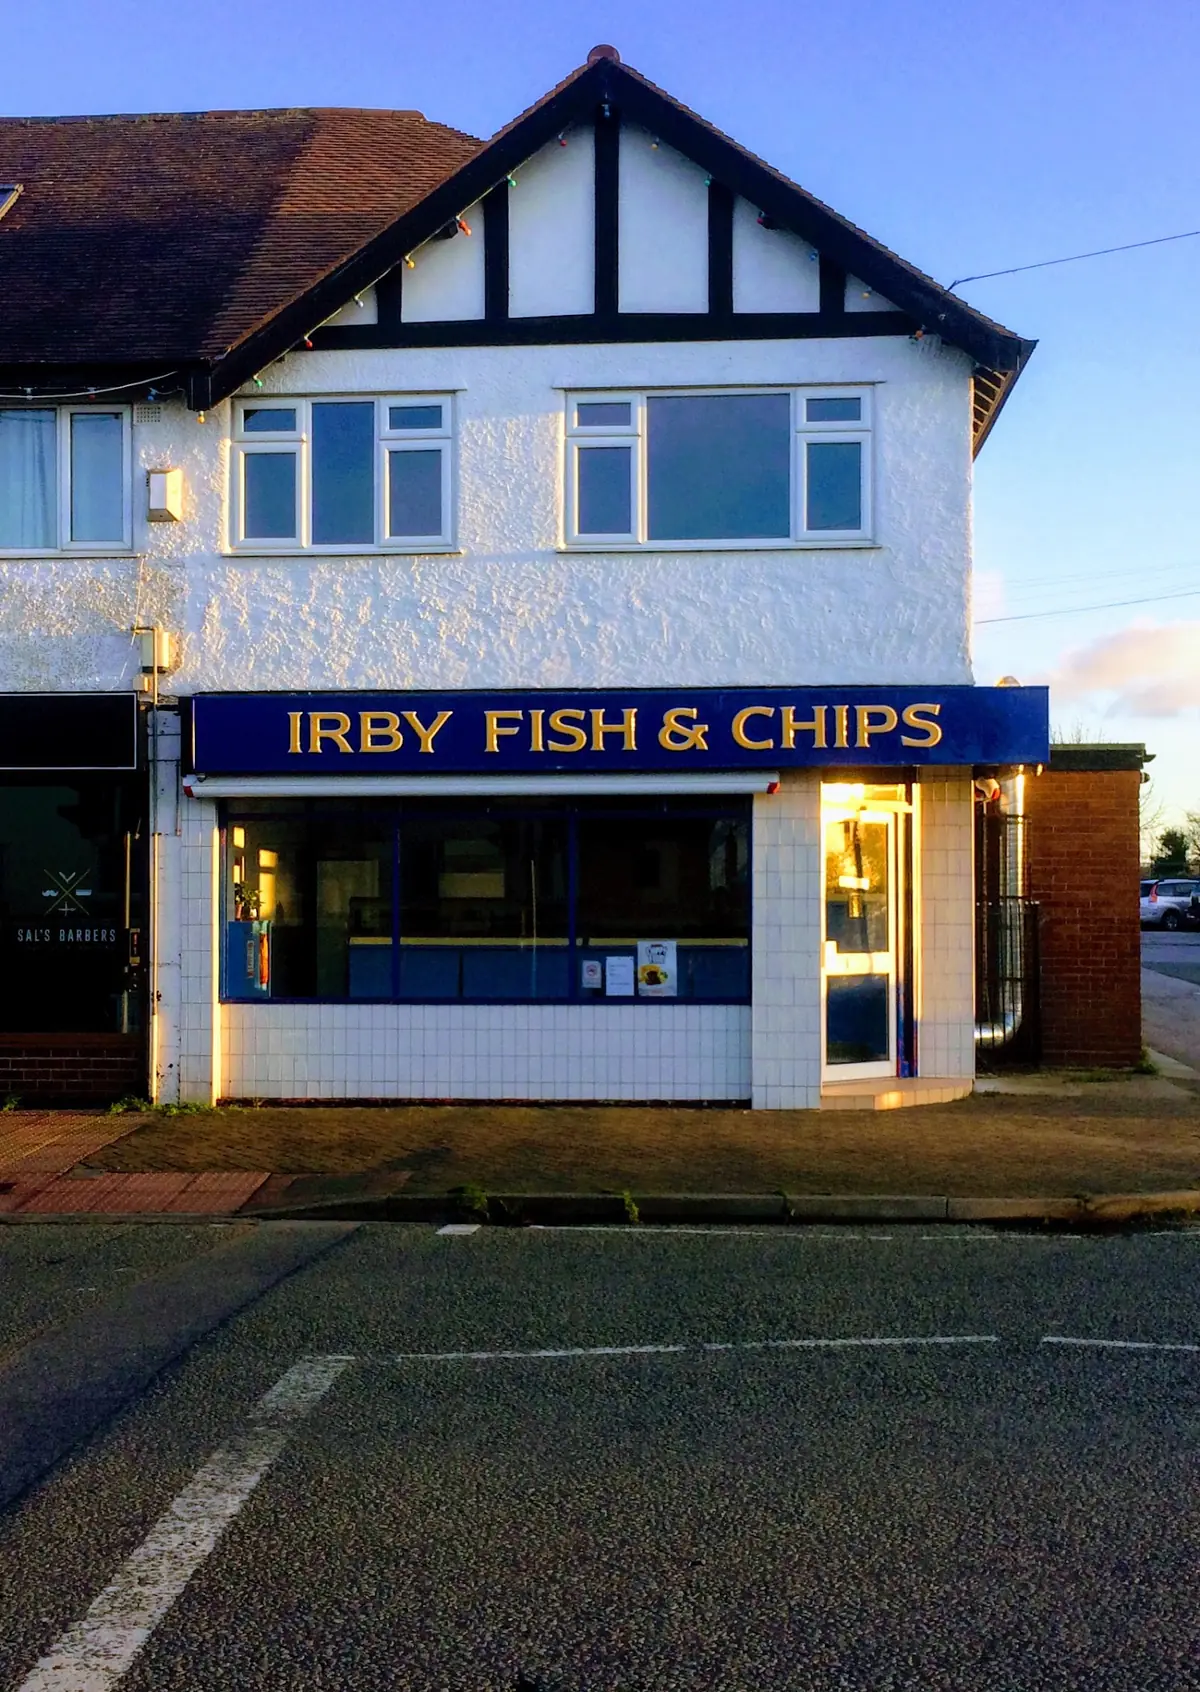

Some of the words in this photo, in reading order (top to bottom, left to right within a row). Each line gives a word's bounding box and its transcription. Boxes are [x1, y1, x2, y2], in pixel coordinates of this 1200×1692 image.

[287, 709, 454, 755] IRBY
[483, 707, 638, 754] FISH
[658, 707, 708, 752] &
[730, 702, 944, 751] CHIPS
[17, 929, 51, 942] SAL'S
[59, 929, 116, 942] BARBERS
